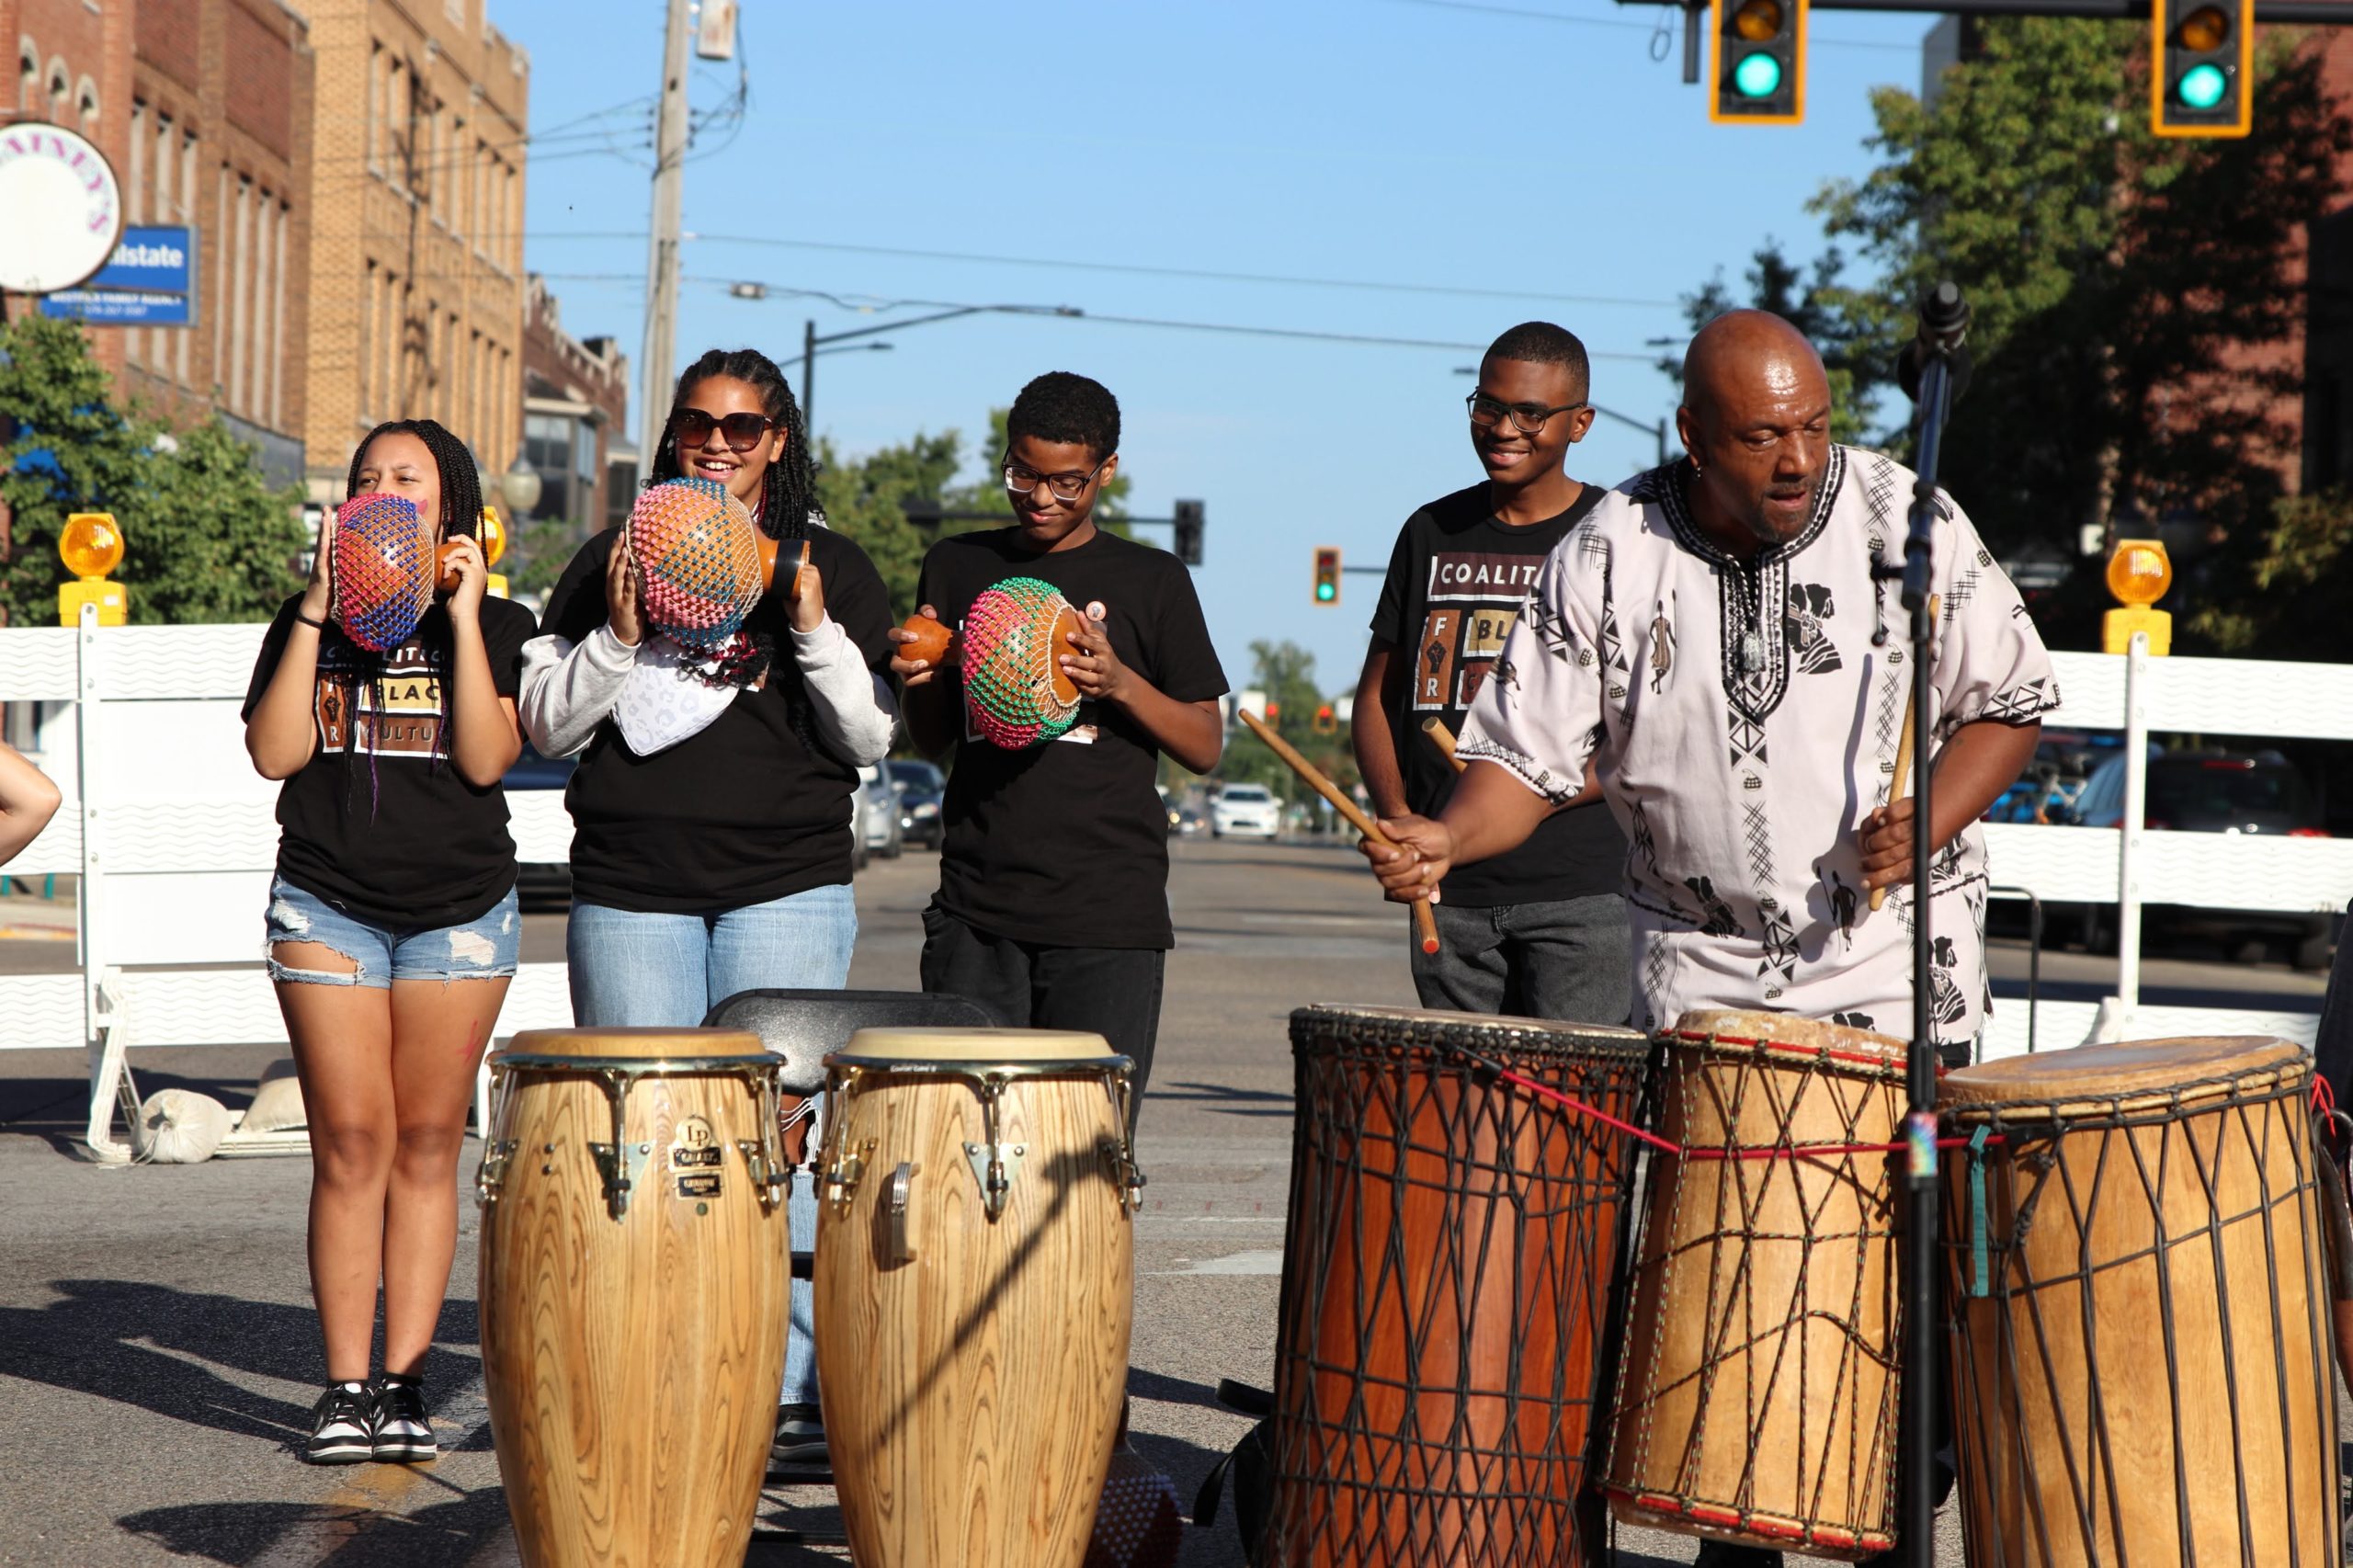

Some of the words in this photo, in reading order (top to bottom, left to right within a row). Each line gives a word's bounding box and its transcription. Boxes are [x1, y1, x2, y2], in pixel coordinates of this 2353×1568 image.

[109, 244, 184, 269] llstate
[1440, 562, 1538, 585] COALIT
[688, 1125, 709, 1147] LP
